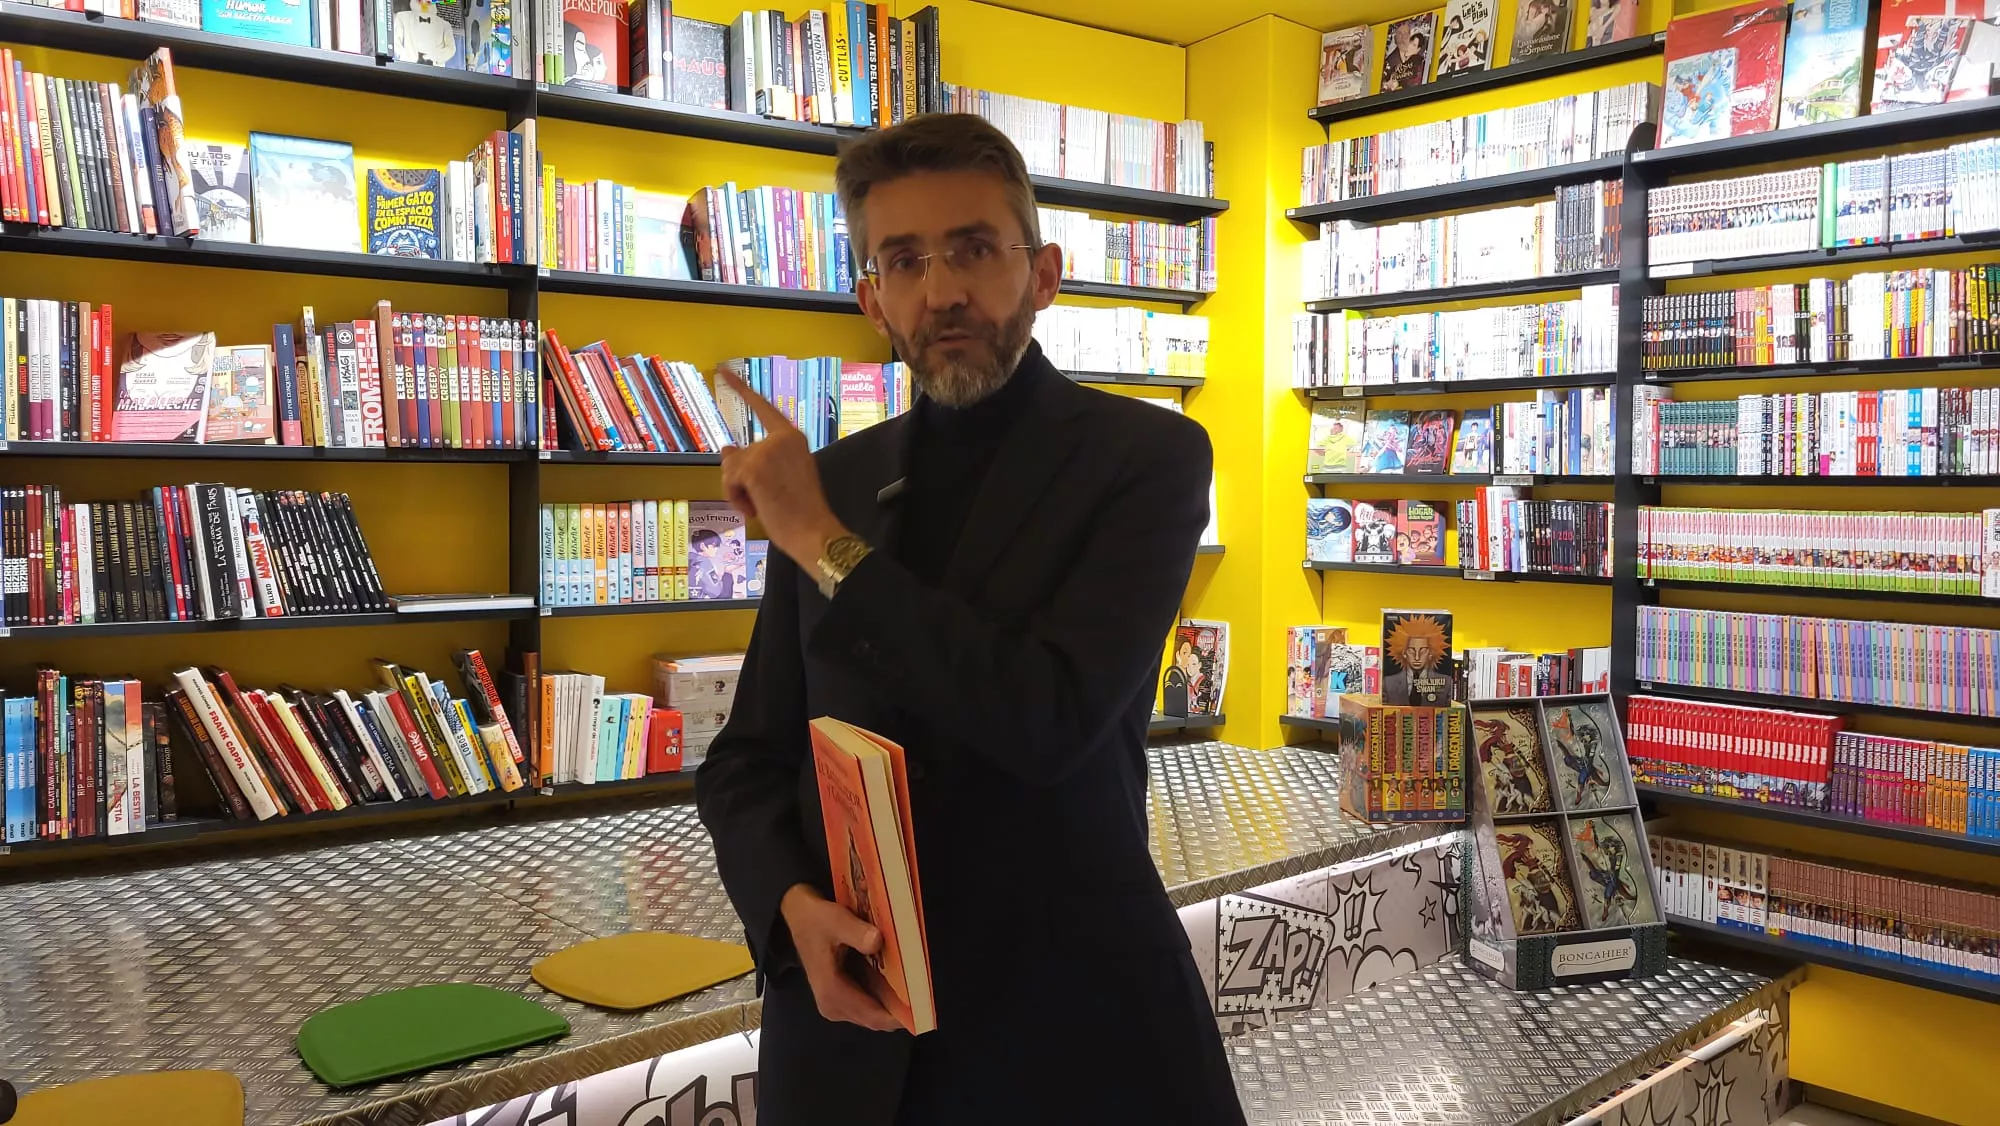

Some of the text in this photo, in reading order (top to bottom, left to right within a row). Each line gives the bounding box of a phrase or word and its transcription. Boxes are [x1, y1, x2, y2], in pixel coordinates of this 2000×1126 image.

[1462, 1, 1483, 18] Let's
[1472, 7, 1488, 22] Play
[674, 56, 727, 78] MAUS
[811, 33, 826, 92] MONSTRUOS
[837, 37, 849, 83] CUTTLAS
[868, 31, 879, 112] ANTES DEL INCAL
[904, 40, 914, 71] PERSEO
[376, 190, 435, 210] PRIMER GATO
[376, 205, 433, 217] EN EL ESPACIO
[408, 215, 434, 230] PIZZA
[340, 355, 352, 384] USAGI
[395, 364, 406, 400] EERIE
[405, 365, 414, 400] CREEPY
[417, 364, 428, 400] EERIE
[428, 365, 438, 400] CREEPY
[439, 366, 449, 401] CREEPY
[449, 367, 458, 402] EERIE
[461, 366, 470, 402] EERIE
[471, 367, 481, 402] EERIE
[482, 368, 491, 402] CREEPY
[491, 368, 500, 402] CREEPY
[502, 368, 512, 402] CREEPY
[514, 369, 523, 403] CREEPY
[527, 370, 536, 403] CREEPY
[360, 381, 385, 447] FROM
[688, 513, 740, 524] Boyfriends
[1408, 506, 1434, 515] HOGAR
[212, 513, 227, 567] LA DAMA DE
[250, 540, 272, 579] MADMAN
[333, 548, 343, 567] YODA
[4, 558, 13, 594] BRZRKR
[12, 558, 20, 594] BRZRKR
[20, 557, 28, 594] BRZRKR
[267, 583, 275, 605] ALLRED
[472, 656, 483, 671] IGOR
[1331, 671, 1347, 691] K
[1413, 678, 1445, 687] SHINJUKU
[1416, 685, 1435, 693] SWAN
[208, 710, 245, 770] FRANK CAPPA
[1371, 712, 1379, 772] DRAGON BALL
[1448, 712, 1460, 772] DRAGON BALL
[132, 777, 141, 820] LA BESTIA
[1422, 779, 1429, 787] 4
[1453, 778, 1458, 787] 6
[1219, 915, 1326, 995] ZAP!
